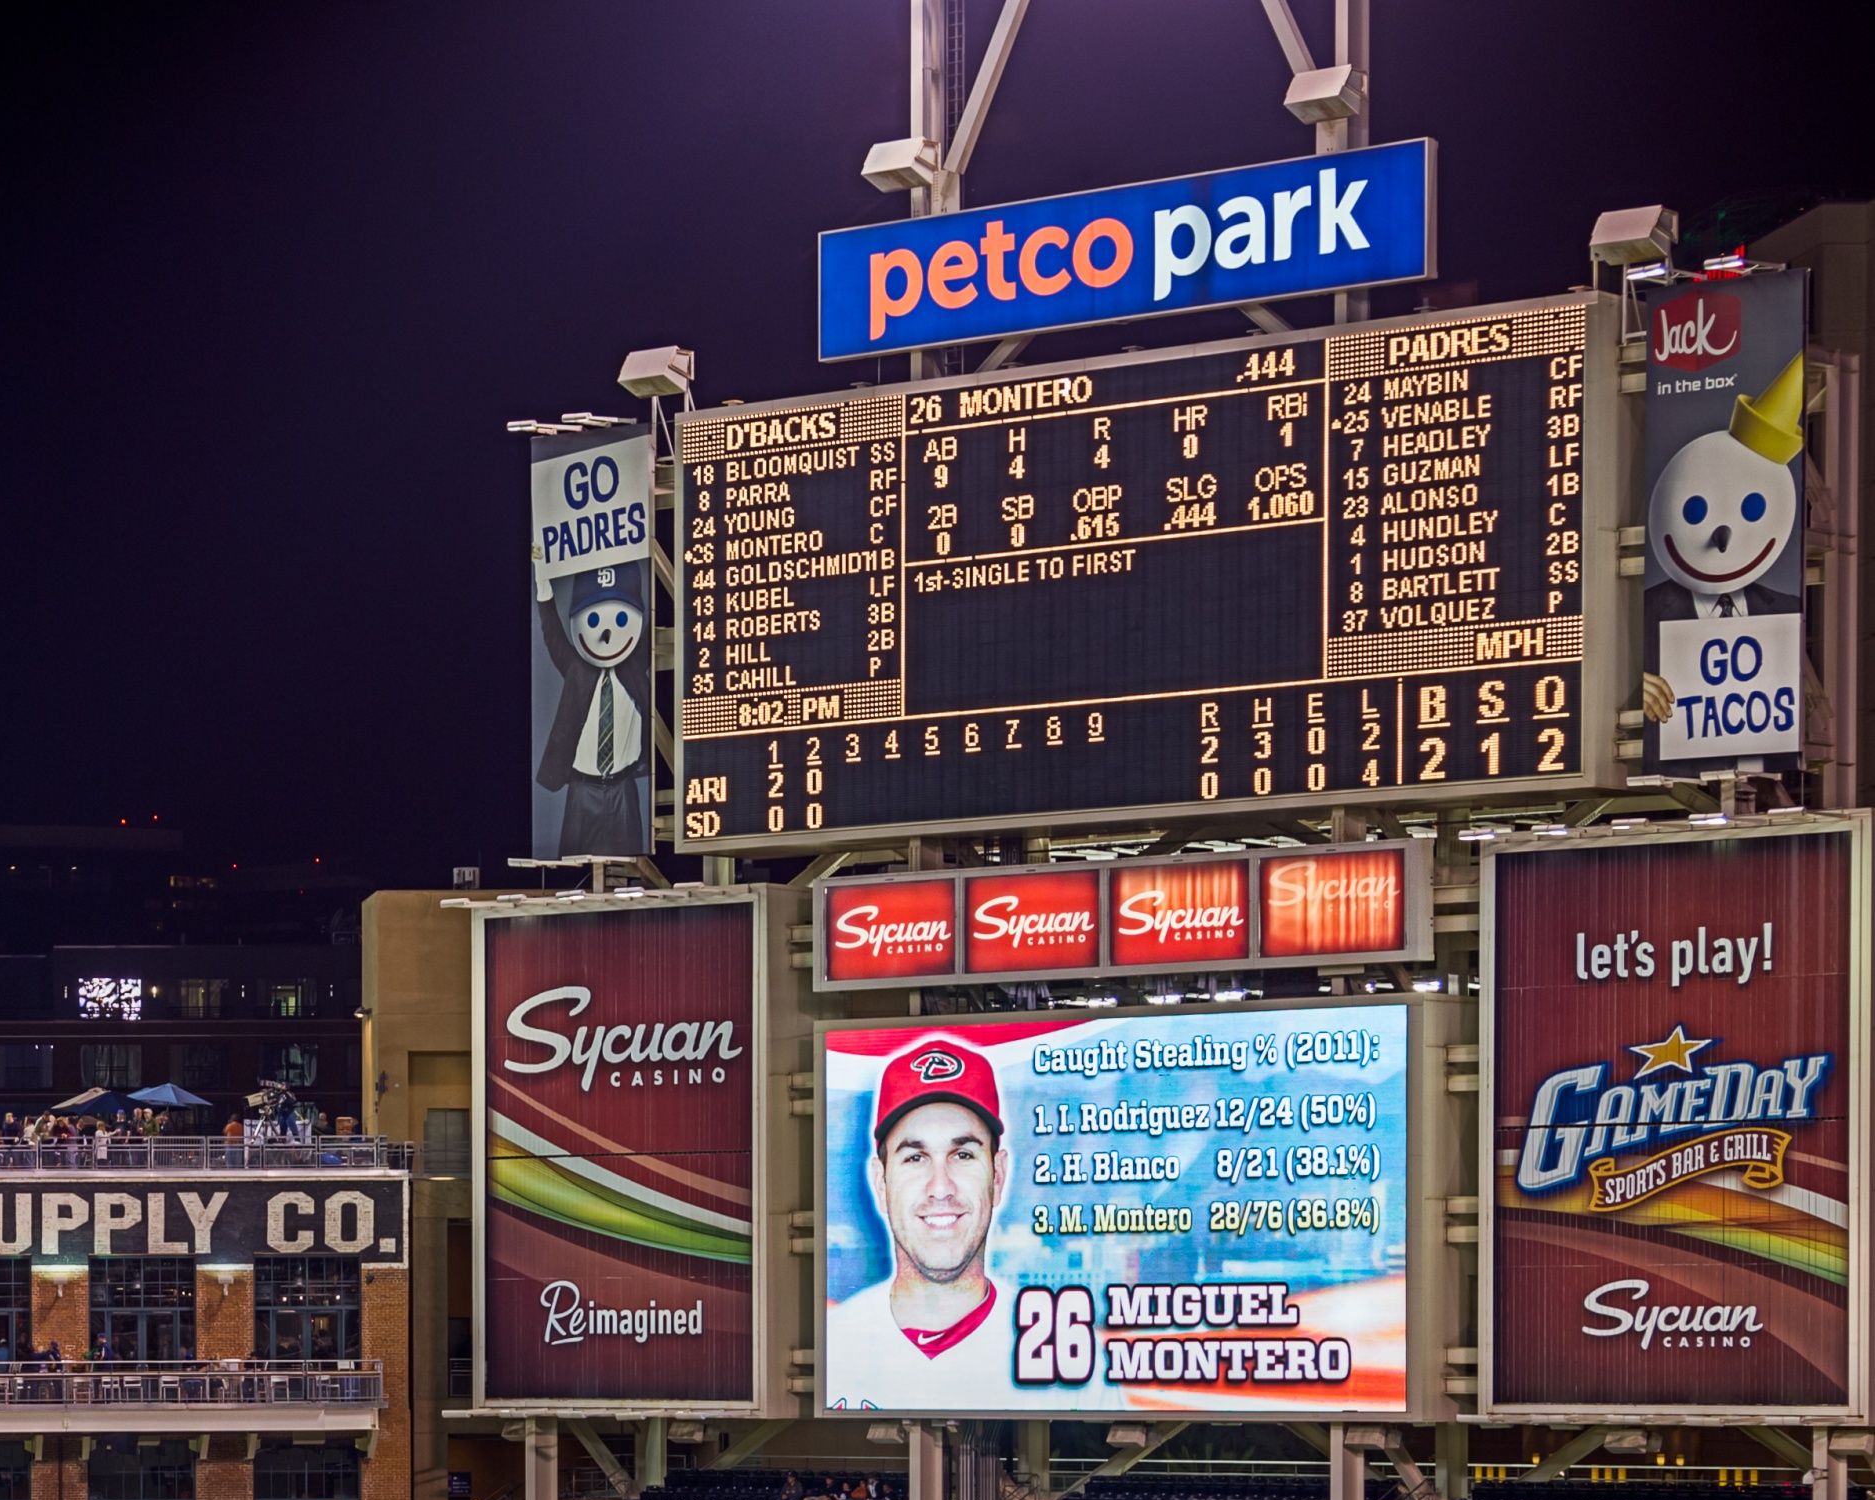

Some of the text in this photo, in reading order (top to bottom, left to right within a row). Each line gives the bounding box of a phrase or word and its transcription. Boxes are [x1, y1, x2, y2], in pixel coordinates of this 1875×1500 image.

[869, 168, 1369, 338] petco park
[1389, 324, 1510, 366] PADRES
[1655, 299, 1737, 361] Jack
[910, 349, 1295, 424] 26 MONTERO .444
[1344, 356, 1583, 405] 24 MAYBIN CF
[1657, 375, 1735, 395] in the box
[725, 415, 836, 450] D'BACKS
[1343, 385, 1583, 434] 25 VENABLE RF
[1352, 415, 1580, 461] 7 HEADLEY 3B
[564, 455, 619, 510] GO
[693, 443, 895, 485] 18 BLOOMQUIST SS
[542, 502, 646, 564] PADRES
[914, 550, 1135, 591] 1st-SINGLE TO FIRST
[693, 603, 894, 642] 14 ROBERTS 3B
[1700, 636, 1762, 685] GO
[739, 695, 840, 726] 8:02 PM
[1677, 687, 1795, 740] TACOS
[835, 905, 952, 957] Sycuan
[973, 895, 1095, 947] Sycuan
[1027, 933, 1087, 946] CASINO
[1118, 890, 1244, 944] Sycuan
[1174, 927, 1236, 941] CASINO
[886, 942, 944, 955] CASINO
[1576, 922, 1772, 987] let's play!
[504, 986, 742, 1091] Sycuan
[1033, 1030, 1380, 1078] Caught Stealing % (2011):
[610, 1067, 725, 1088] CASINO
[1035, 1092, 1377, 1137] 1. I. Rodriguez 12/24 (50%)
[1034, 1145, 1381, 1184] 2. H. Blanco 8/21 (38.1%)
[1604, 1133, 1771, 1205] SPORTS BAR & GRILL
[266, 1191, 397, 1254] CO.
[1034, 1199, 1381, 1234] 3. M. Montero 28/76 (36.8%)
[540, 1280, 703, 1345] Reimagined
[1106, 1284, 1299, 1327] MIGUEL
[1582, 1279, 1763, 1350] Sycuan
[1015, 1287, 1094, 1382] 26
[1663, 1335, 1751, 1348] CASINO
[1105, 1339, 1351, 1382] MONTERO
